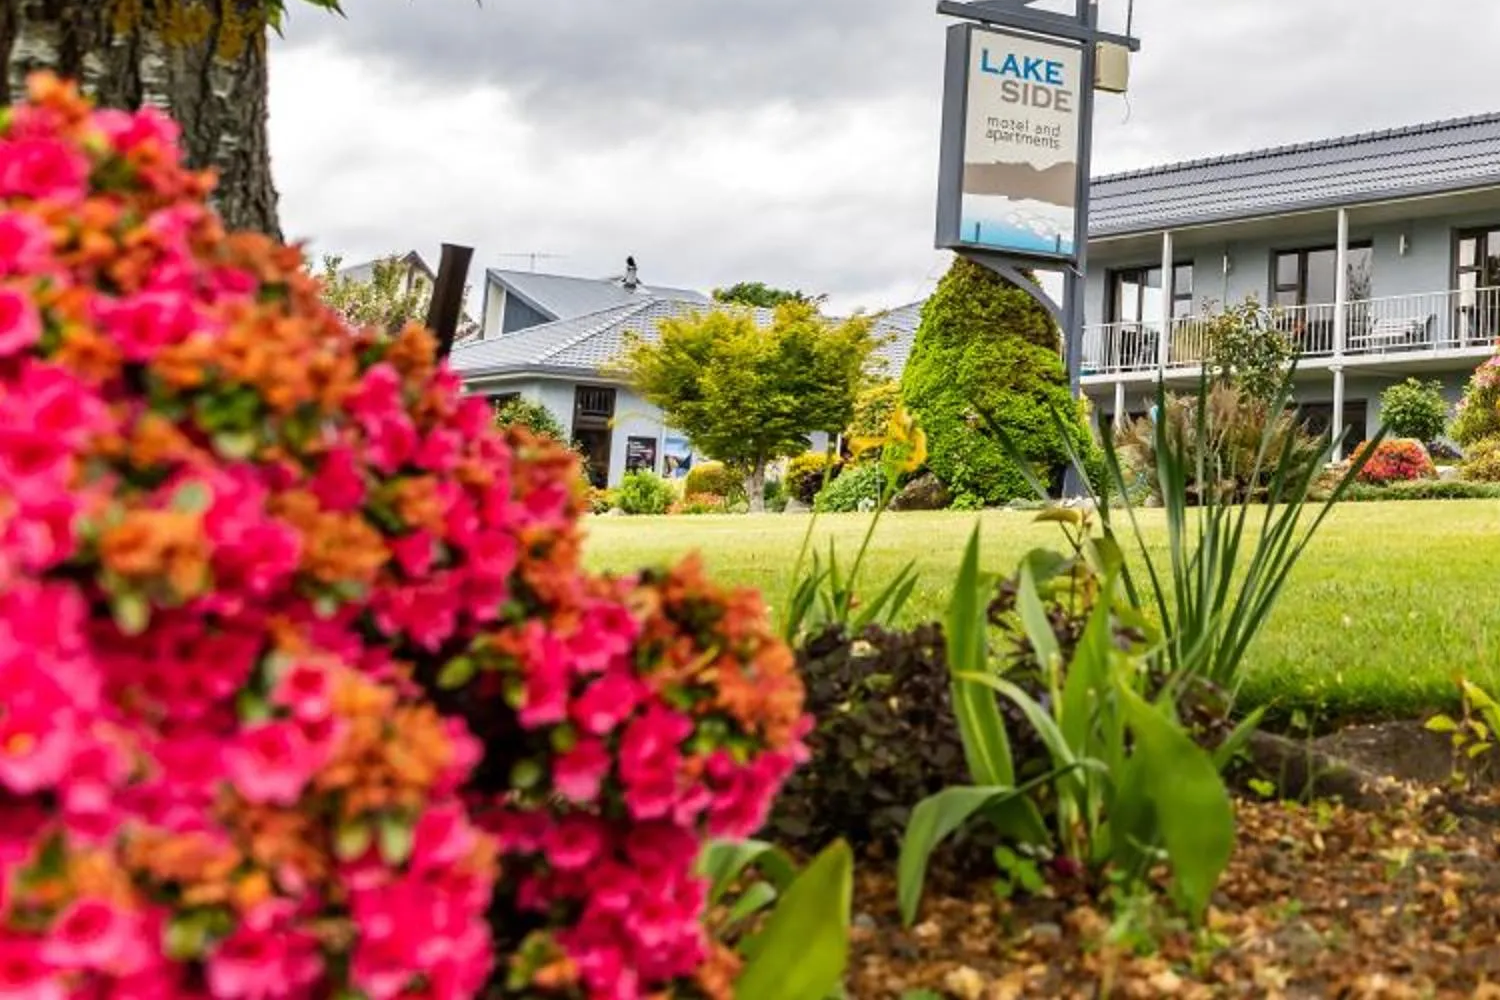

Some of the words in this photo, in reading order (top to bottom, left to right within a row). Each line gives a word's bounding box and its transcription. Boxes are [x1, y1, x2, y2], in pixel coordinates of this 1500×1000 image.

[981, 48, 1064, 85] LAKE
[1001, 80, 1073, 112] SIDE
[985, 129, 1061, 149] apartments
[987, 116, 1029, 131] motel
[1035, 123, 1061, 136] and
